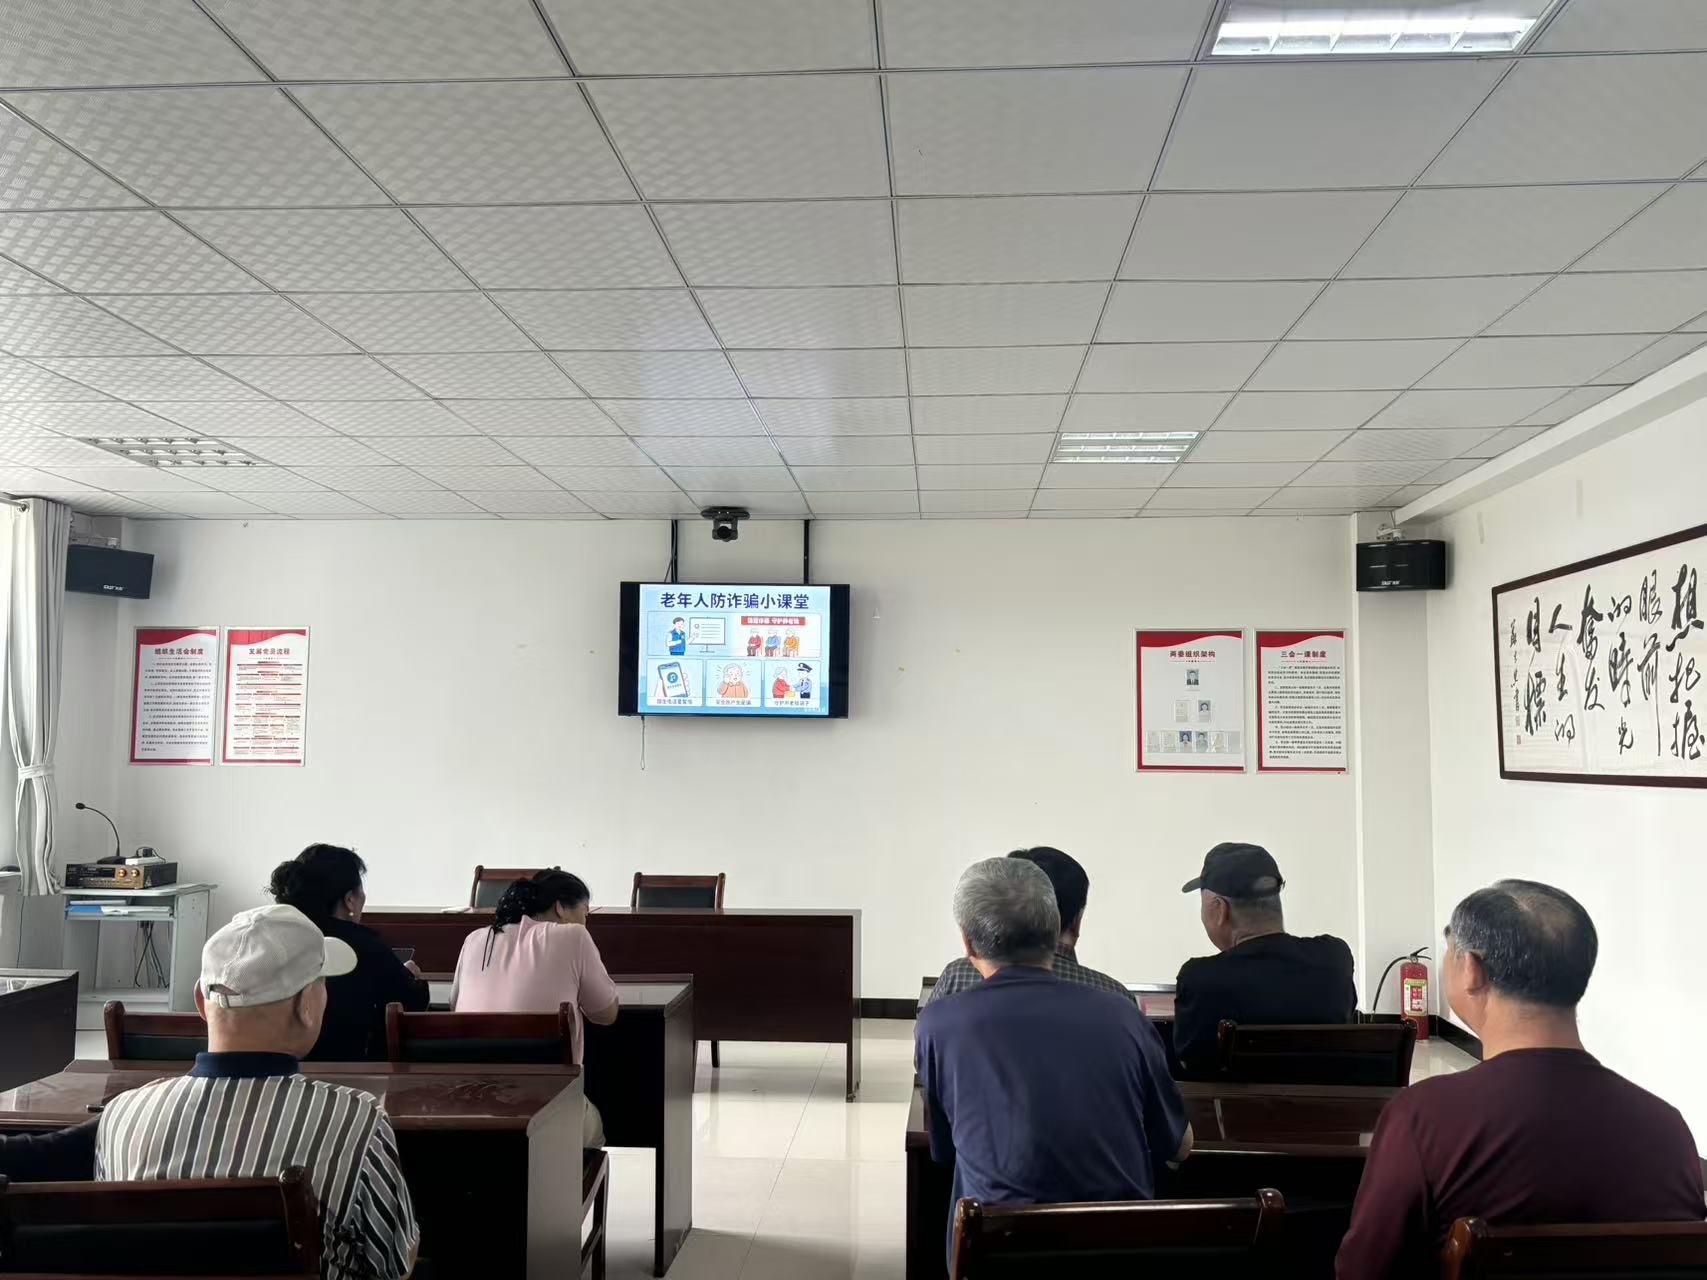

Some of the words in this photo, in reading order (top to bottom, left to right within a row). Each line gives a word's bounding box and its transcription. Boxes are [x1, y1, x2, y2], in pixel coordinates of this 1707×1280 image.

[660, 591, 810, 610] 老年人防诈骗小课堂
[1169, 650, 1216, 658] 两委组织架构
[1280, 650, 1328, 658] 三会一课制度
[1548, 603, 1576, 744] 人生的
[1636, 569, 1663, 757] 眼前
[1665, 563, 1705, 761] 想把握
